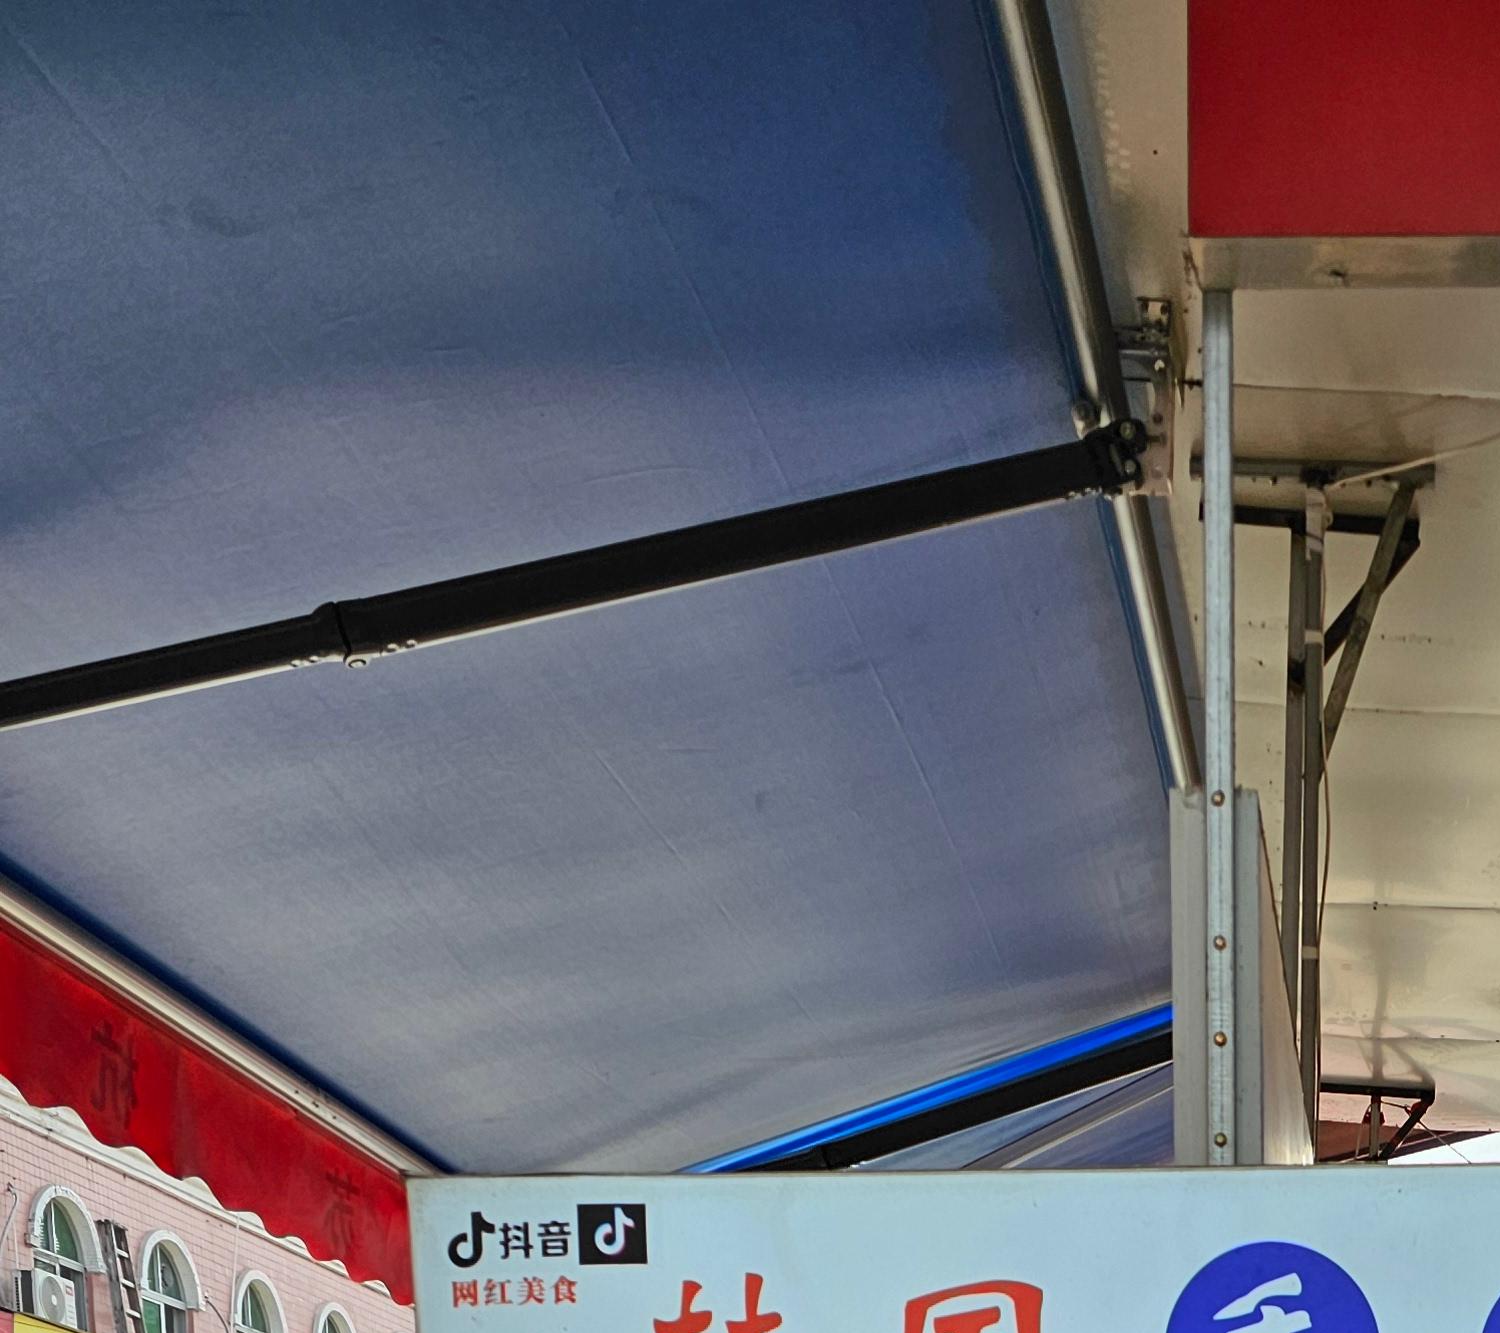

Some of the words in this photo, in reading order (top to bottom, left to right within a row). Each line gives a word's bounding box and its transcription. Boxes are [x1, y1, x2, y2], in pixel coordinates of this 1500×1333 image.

[500, 1219, 573, 1261] 抖音
[450, 1275, 580, 1309] 网红美食
